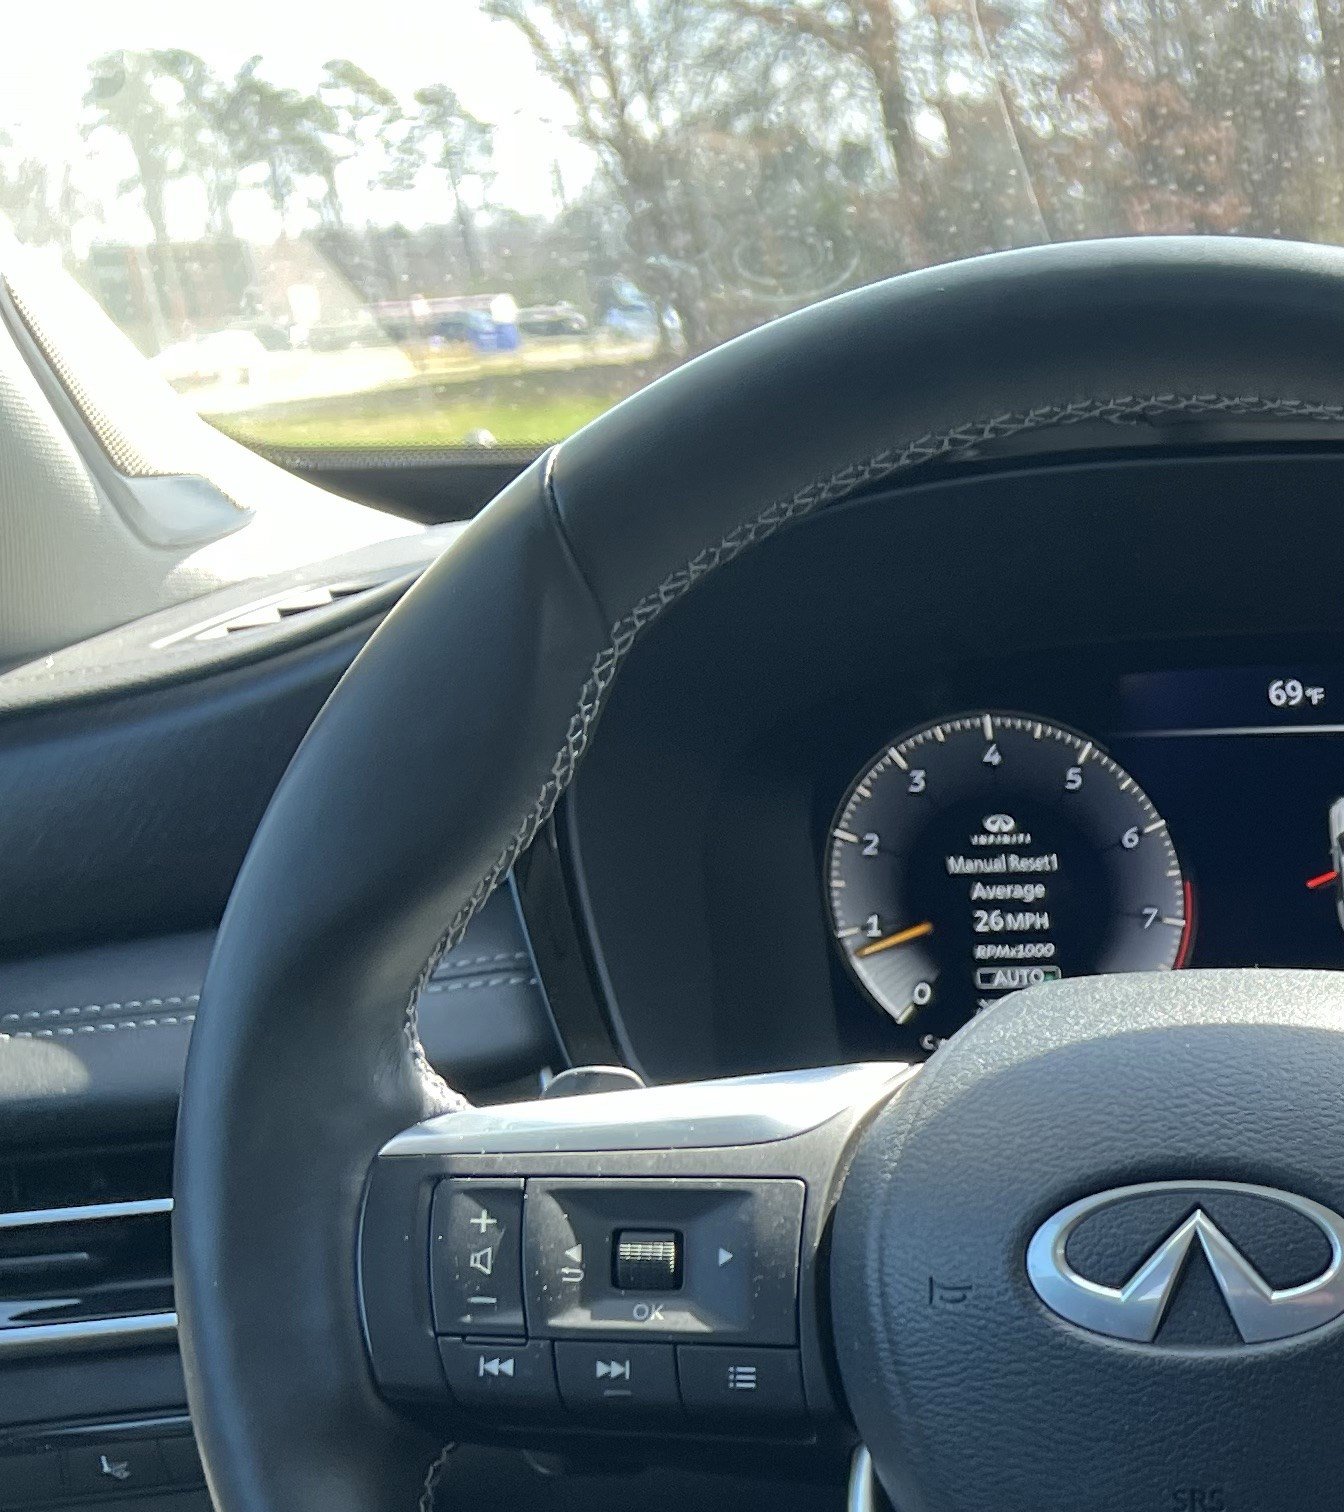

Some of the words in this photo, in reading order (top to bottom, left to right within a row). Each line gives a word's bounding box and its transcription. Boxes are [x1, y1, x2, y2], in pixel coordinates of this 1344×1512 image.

[982, 745, 1002, 766] 4
[908, 770, 926, 793] 3
[1065, 768, 1082, 791] 5
[862, 833, 880, 855] 2
[1121, 827, 1139, 848] 6
[947, 853, 1006, 875] Manual
[970, 880, 1047, 903] Average
[865, 915, 881, 937] 1
[973, 909, 1004, 933] 26
[1005, 911, 1051, 931] MPH
[1142, 908, 1158, 926] 7
[993, 968, 1046, 987] AUTO
[914, 981, 932, 1006] 0
[633, 1303, 665, 1322] OK
